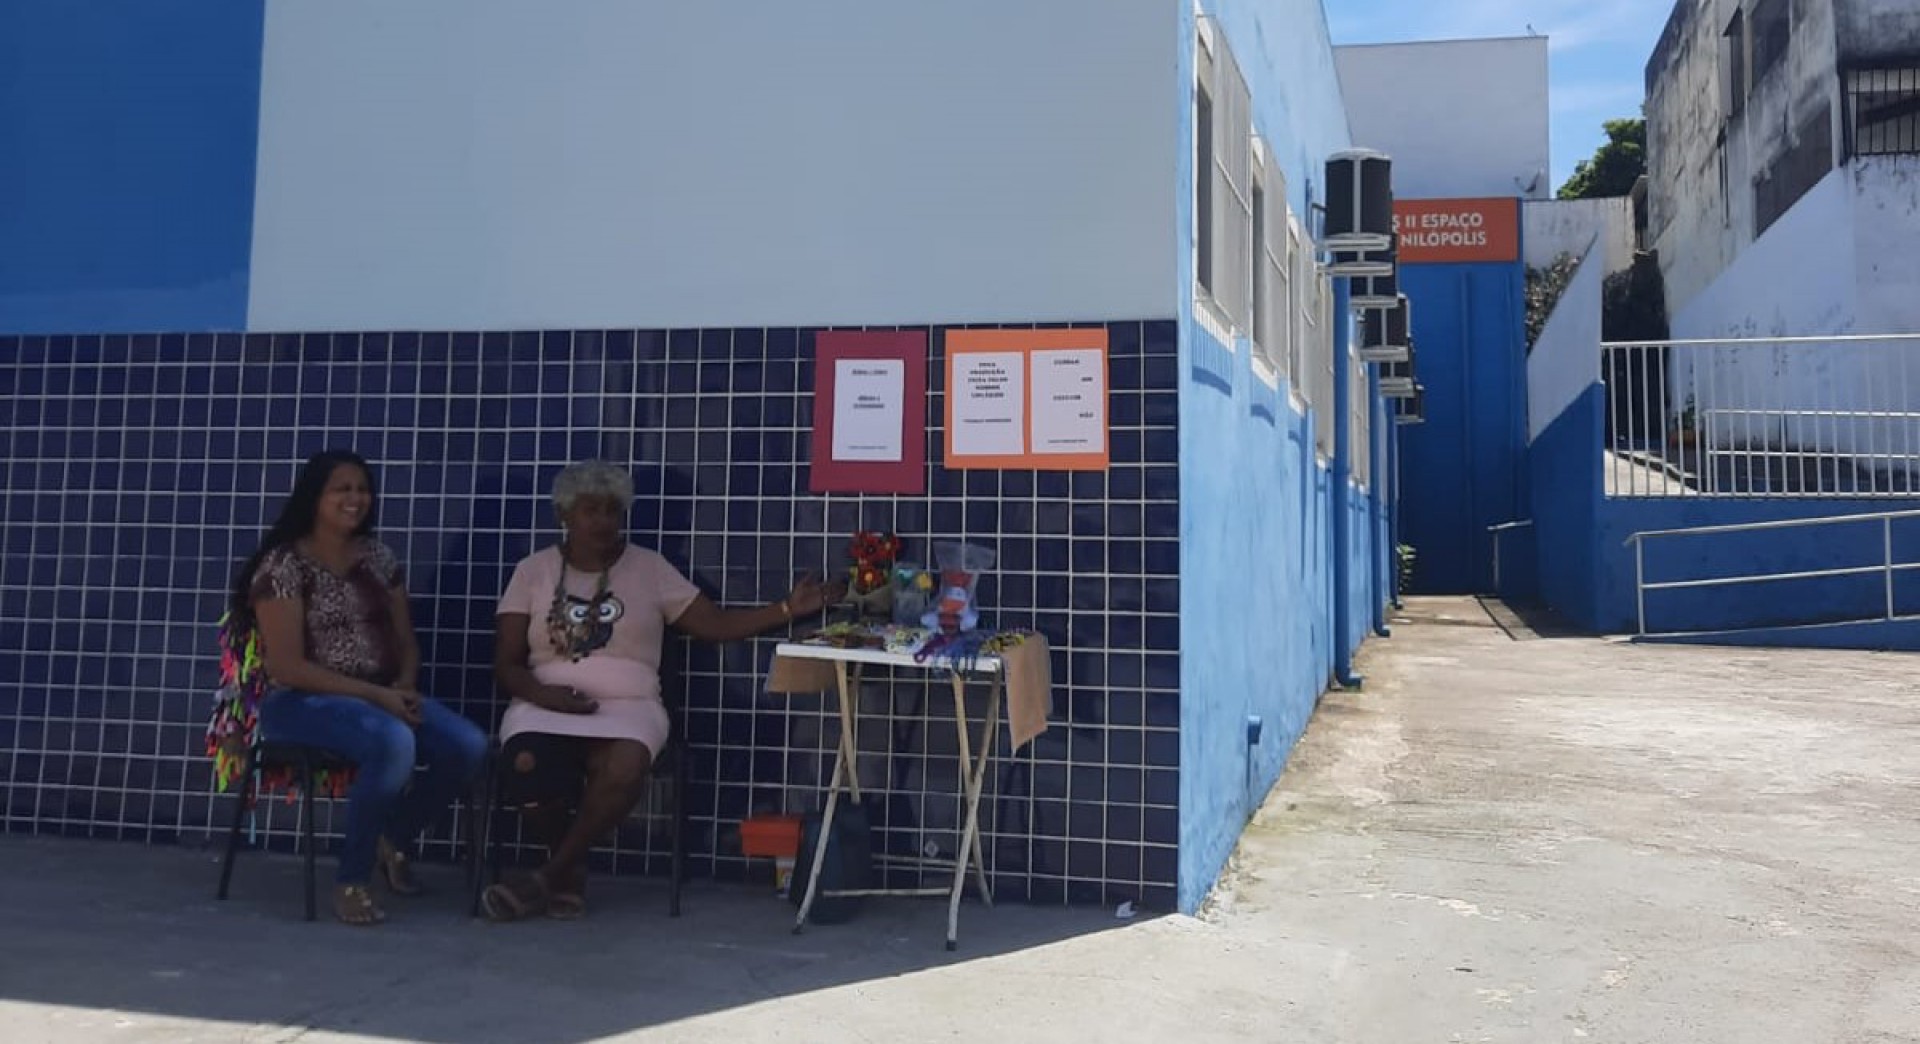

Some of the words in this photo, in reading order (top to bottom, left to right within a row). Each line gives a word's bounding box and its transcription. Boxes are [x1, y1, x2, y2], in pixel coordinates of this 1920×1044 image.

[1405, 214, 1416, 228] II
[1421, 211, 1484, 231] ESPAÇO
[1401, 230, 1487, 247] NILÓPOLIS
